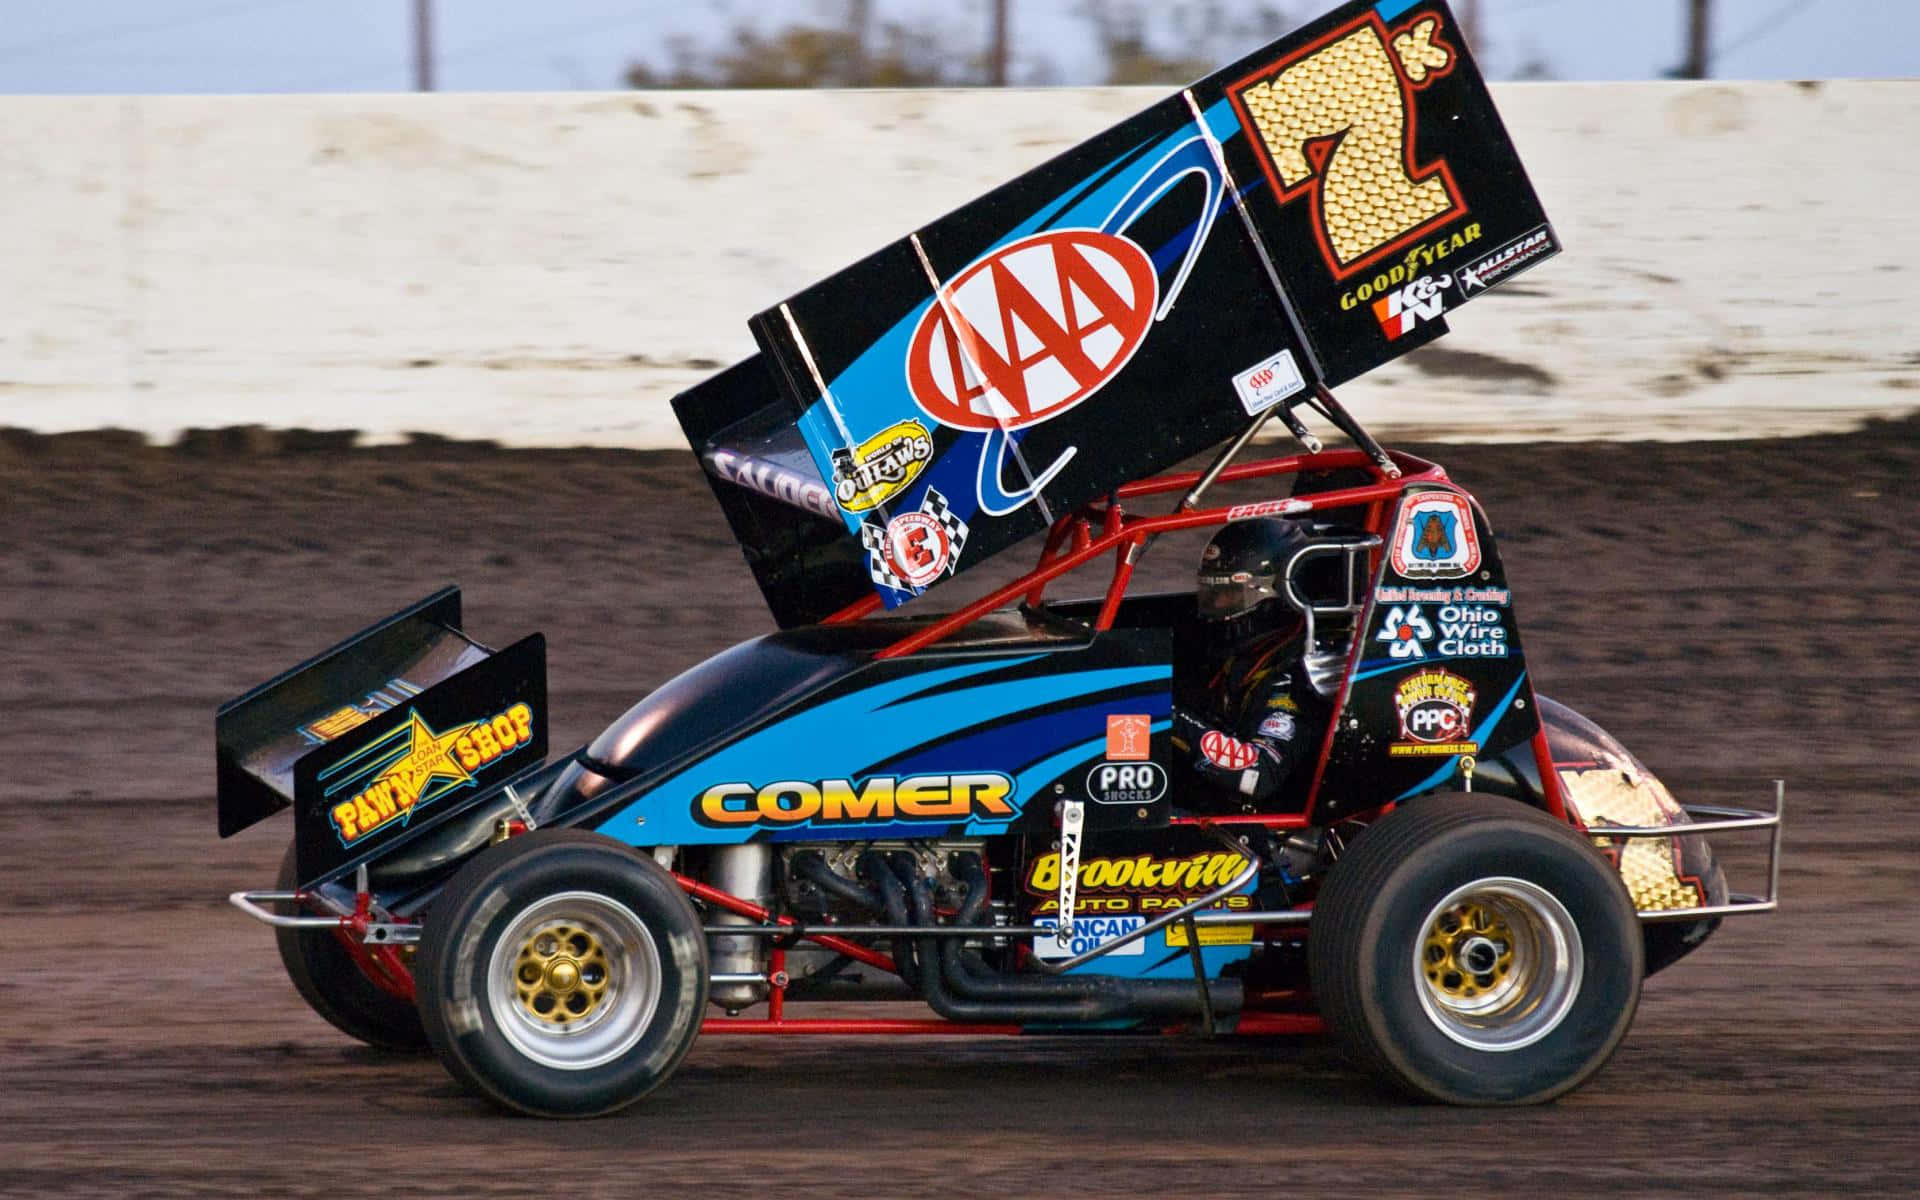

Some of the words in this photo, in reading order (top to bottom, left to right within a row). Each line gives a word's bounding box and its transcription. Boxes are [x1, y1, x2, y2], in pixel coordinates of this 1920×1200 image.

[1234, 18, 1460, 274] 7
[1340, 222, 1483, 311] GOODYEAR
[1476, 229, 1548, 274] ALLSTAR
[1388, 274, 1453, 335] K&N
[922, 235, 1145, 424] AAA
[904, 526, 936, 569] E
[1438, 605, 1498, 622] Ohio
[1439, 622, 1504, 639] Wire
[1437, 639, 1505, 656] Cloth
[1412, 708, 1457, 731] PPC
[410, 741, 442, 765] LOAN
[415, 753, 446, 777] STAR
[1204, 731, 1257, 769] AAA
[333, 769, 421, 842] PAWN
[455, 703, 533, 771] SHOP
[1100, 765, 1154, 791] PRO
[700, 773, 1015, 824] COMER
[1104, 790, 1152, 801] SHOCKS
[1031, 852, 1251, 891] Bookvill
[1142, 896, 1249, 911] PAS
[1041, 919, 1138, 938] DNCAN
